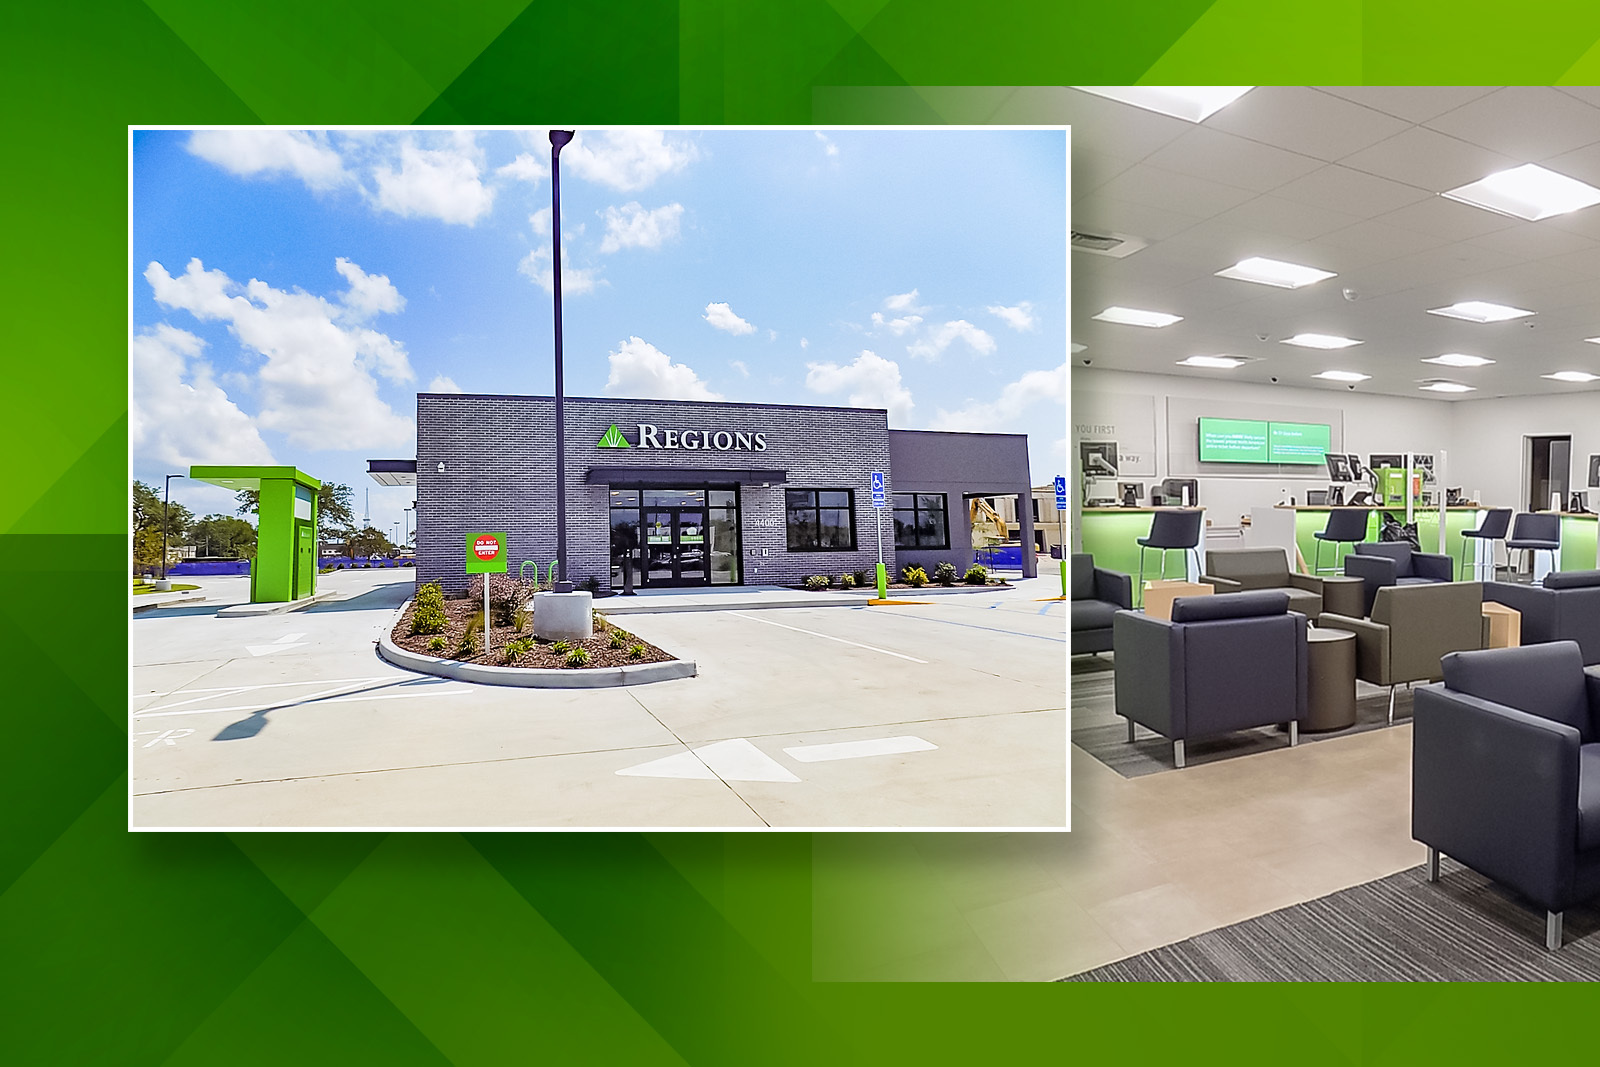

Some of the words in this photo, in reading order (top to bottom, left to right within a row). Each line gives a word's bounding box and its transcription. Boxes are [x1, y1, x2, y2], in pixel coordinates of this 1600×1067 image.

[636, 423, 767, 451] REGIONS
[1075, 424, 1092, 434] YOU
[1094, 425, 1115, 435] FIRST
